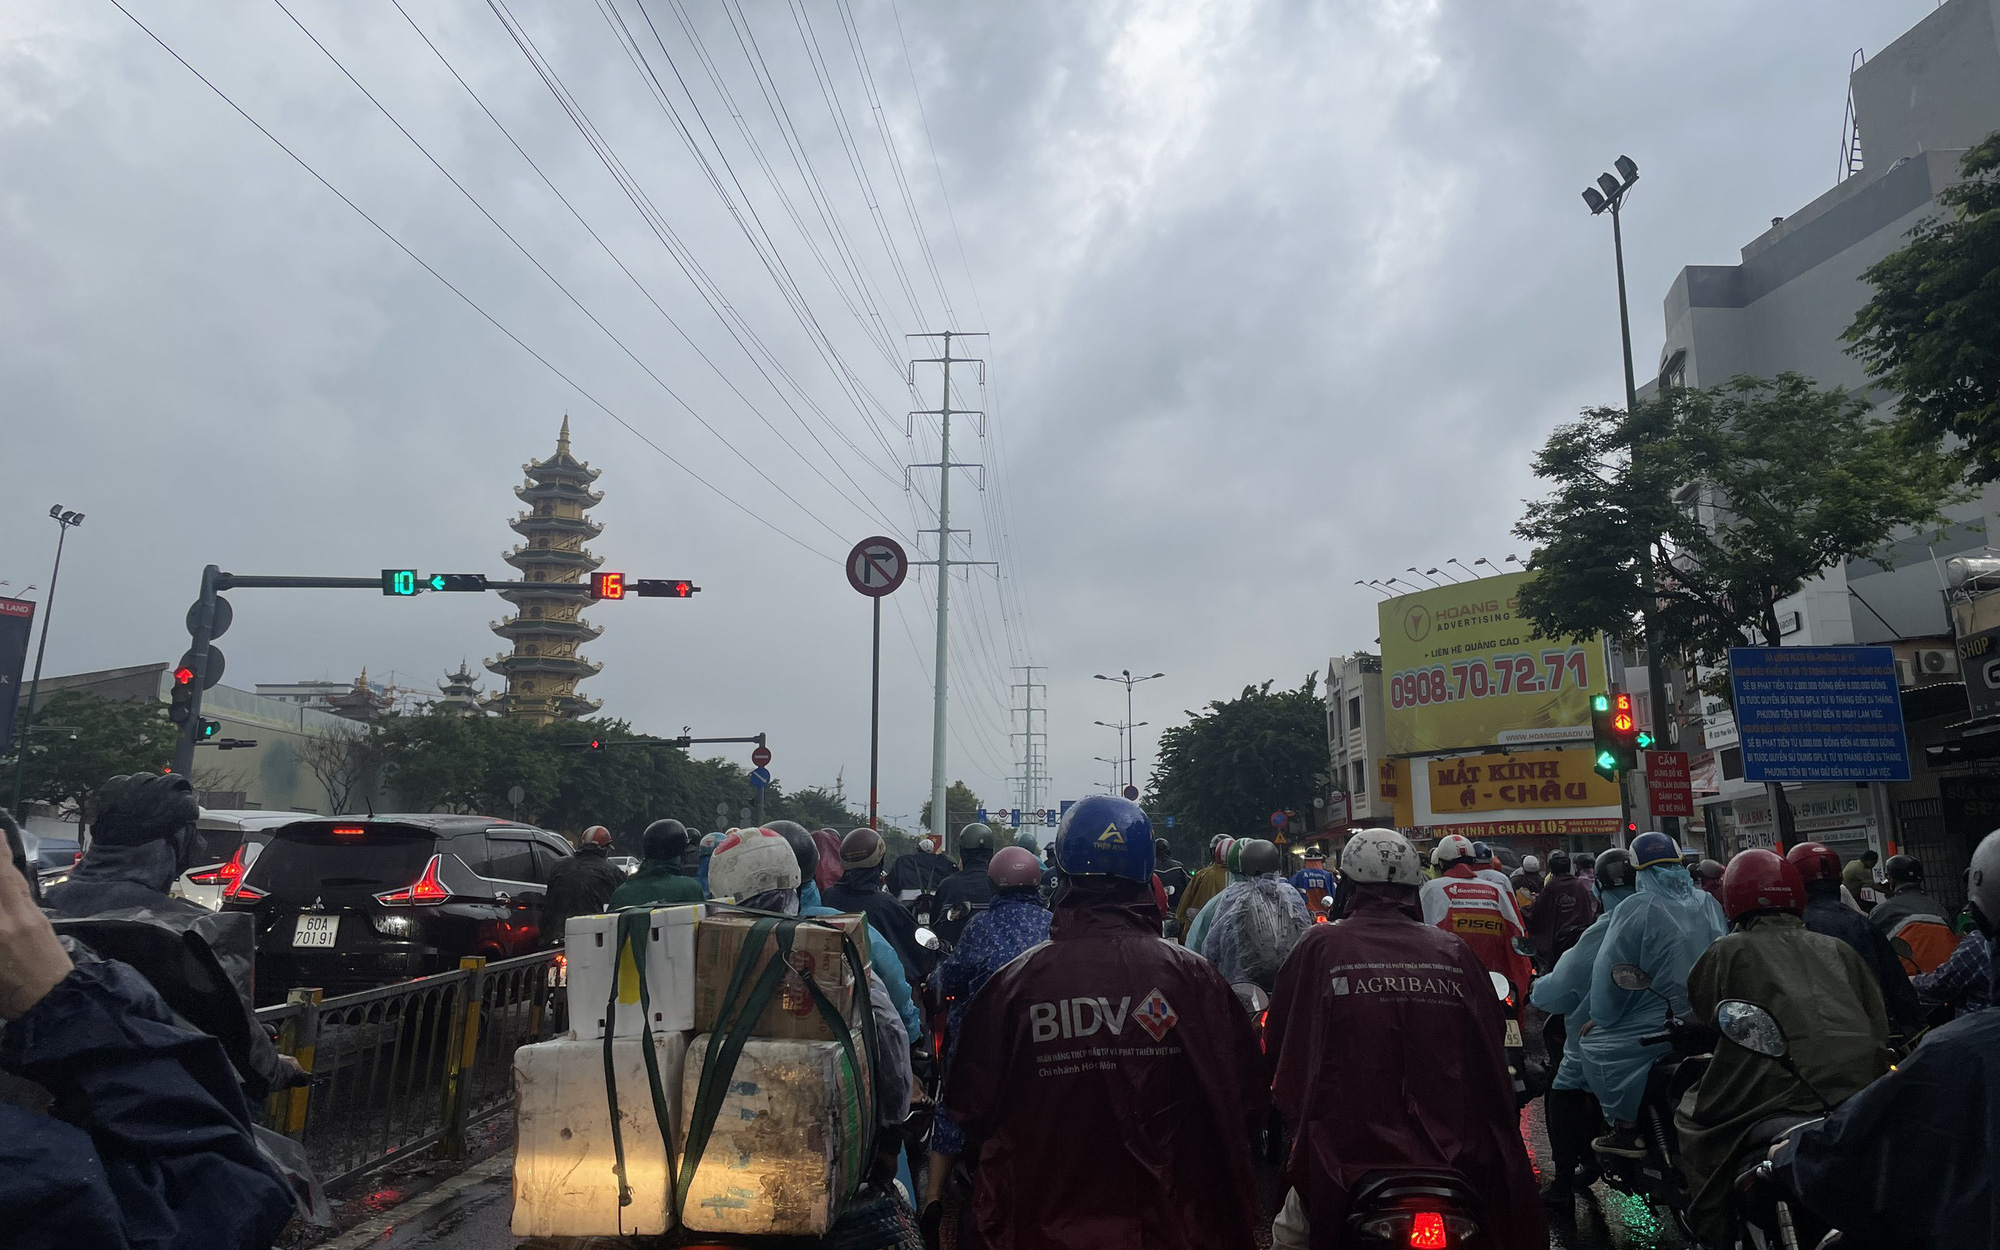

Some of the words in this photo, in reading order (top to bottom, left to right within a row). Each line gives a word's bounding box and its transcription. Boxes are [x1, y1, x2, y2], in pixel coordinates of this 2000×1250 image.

[394, 571, 414, 595] 10
[602, 575, 621, 598] 16
[6, 603, 28, 613] LAND
[1437, 612, 1510, 632] ADVERTISING
[1500, 636, 1520, 647] CÁO
[1959, 637, 1989, 660] SHOP
[1390, 650, 1590, 710] 0908.70.72.71
[1658, 752, 1677, 766] CẤM
[1437, 759, 1481, 786] MẮT
[1488, 758, 1560, 782] KÍNH
[1499, 780, 1587, 803] CHÂU
[1738, 811, 1751, 824] MUA
[1458, 822, 1485, 836] KÍNH
[1499, 819, 1536, 834] CHÂU
[1537, 820, 1566, 834] 405
[1050, 876, 1059, 889] 8
[307, 918, 328, 931] 60A
[296, 932, 332, 944] 701.91
[1354, 977, 1464, 998] AGRIBANK
[1030, 996, 1132, 1043] BIDV
[1039, 1067, 1052, 1078] Chi
[1053, 1063, 1080, 1076] nhánh
